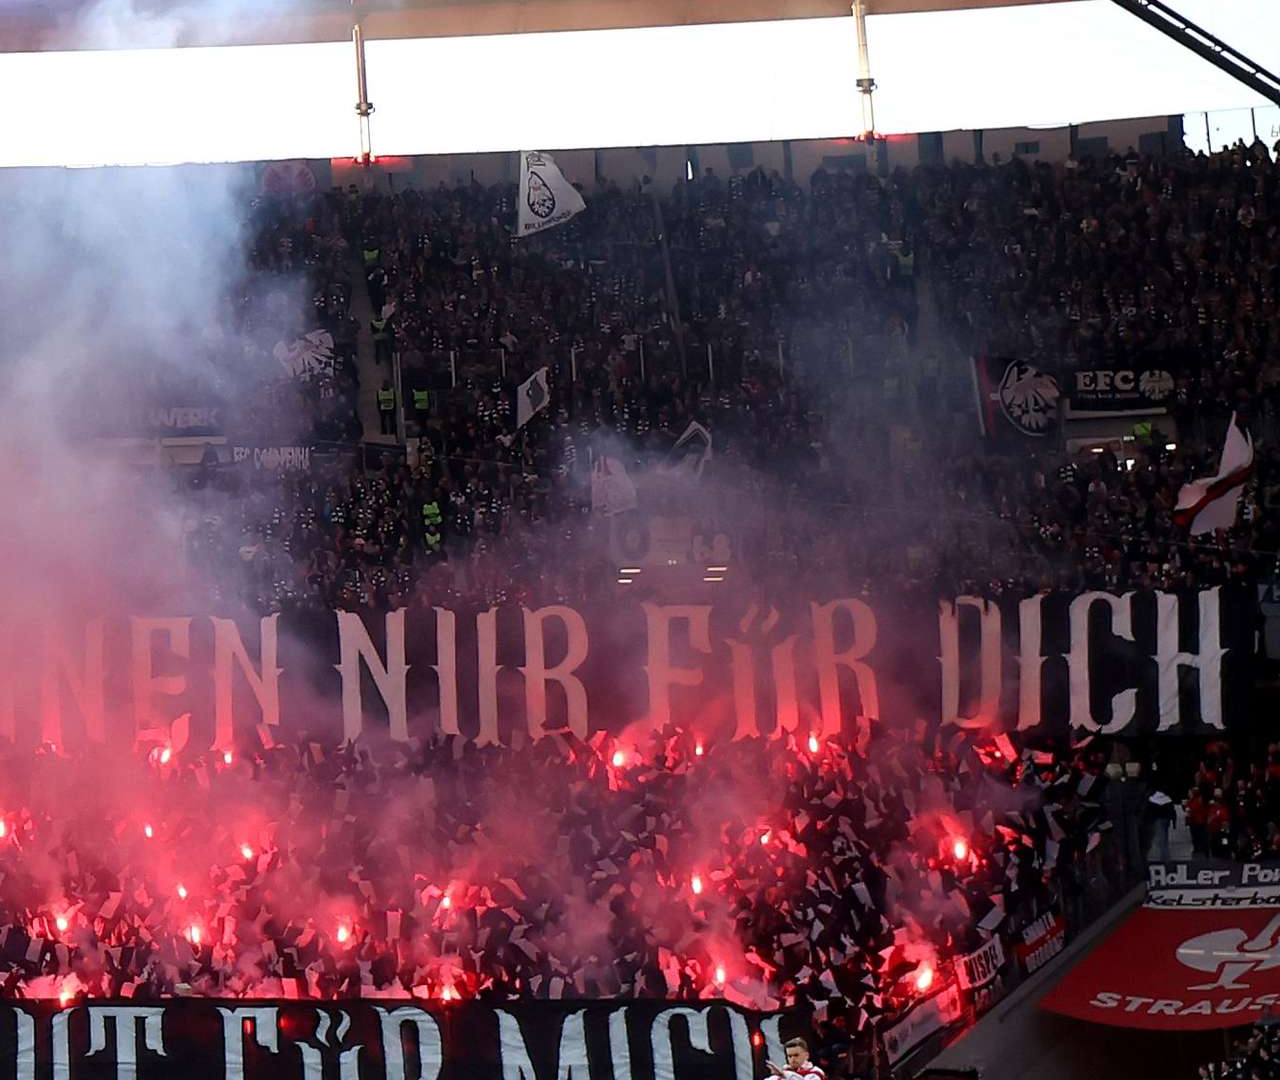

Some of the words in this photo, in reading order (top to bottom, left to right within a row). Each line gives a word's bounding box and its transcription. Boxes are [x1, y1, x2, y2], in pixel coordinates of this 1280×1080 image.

[1075, 370, 1136, 391] EFC
[334, 605, 589, 749] NUR
[936, 583, 1230, 734] DICH
